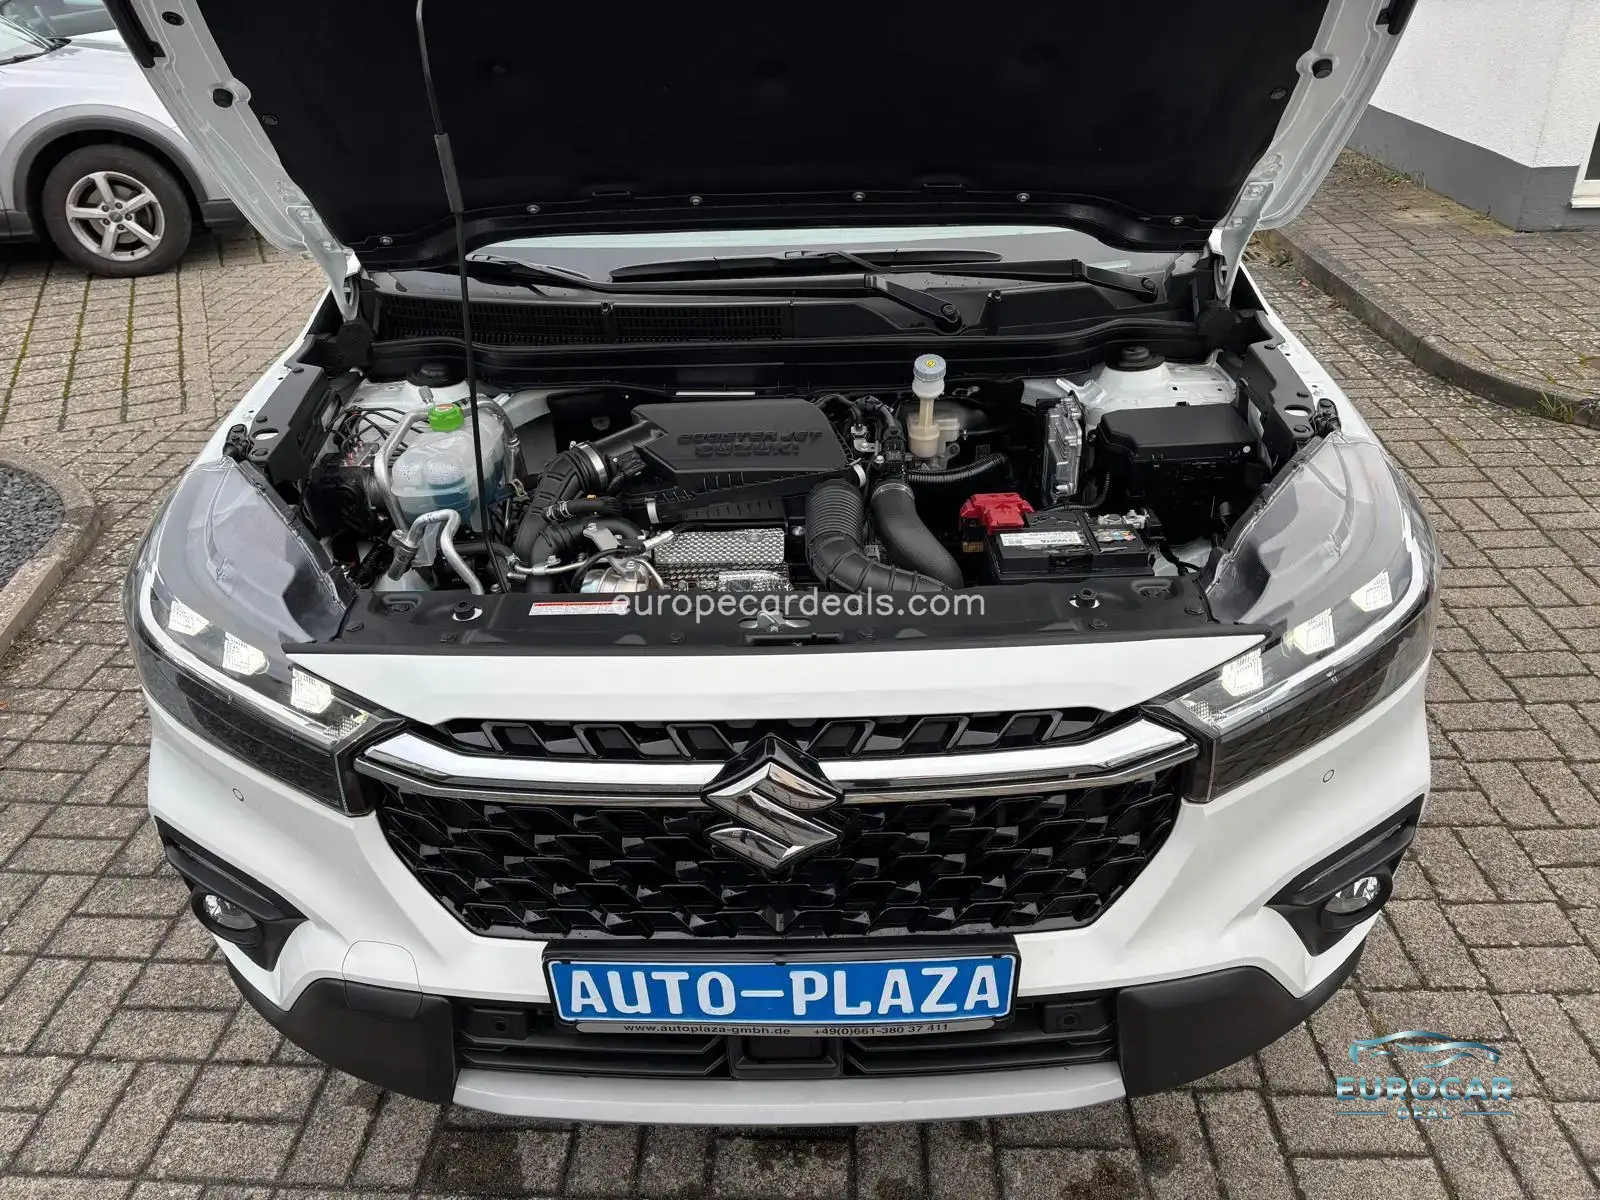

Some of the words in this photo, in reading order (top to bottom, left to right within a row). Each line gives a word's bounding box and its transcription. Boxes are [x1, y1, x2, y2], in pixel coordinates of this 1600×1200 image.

[694, 443, 800, 457] SUZUKI
[623, 1023, 791, 1035] www.autoplaza-gmbh.de
[814, 1025, 904, 1036] +49(0)661-380
[907, 1025, 923, 1033] 37
[927, 1023, 948, 1031] 411
